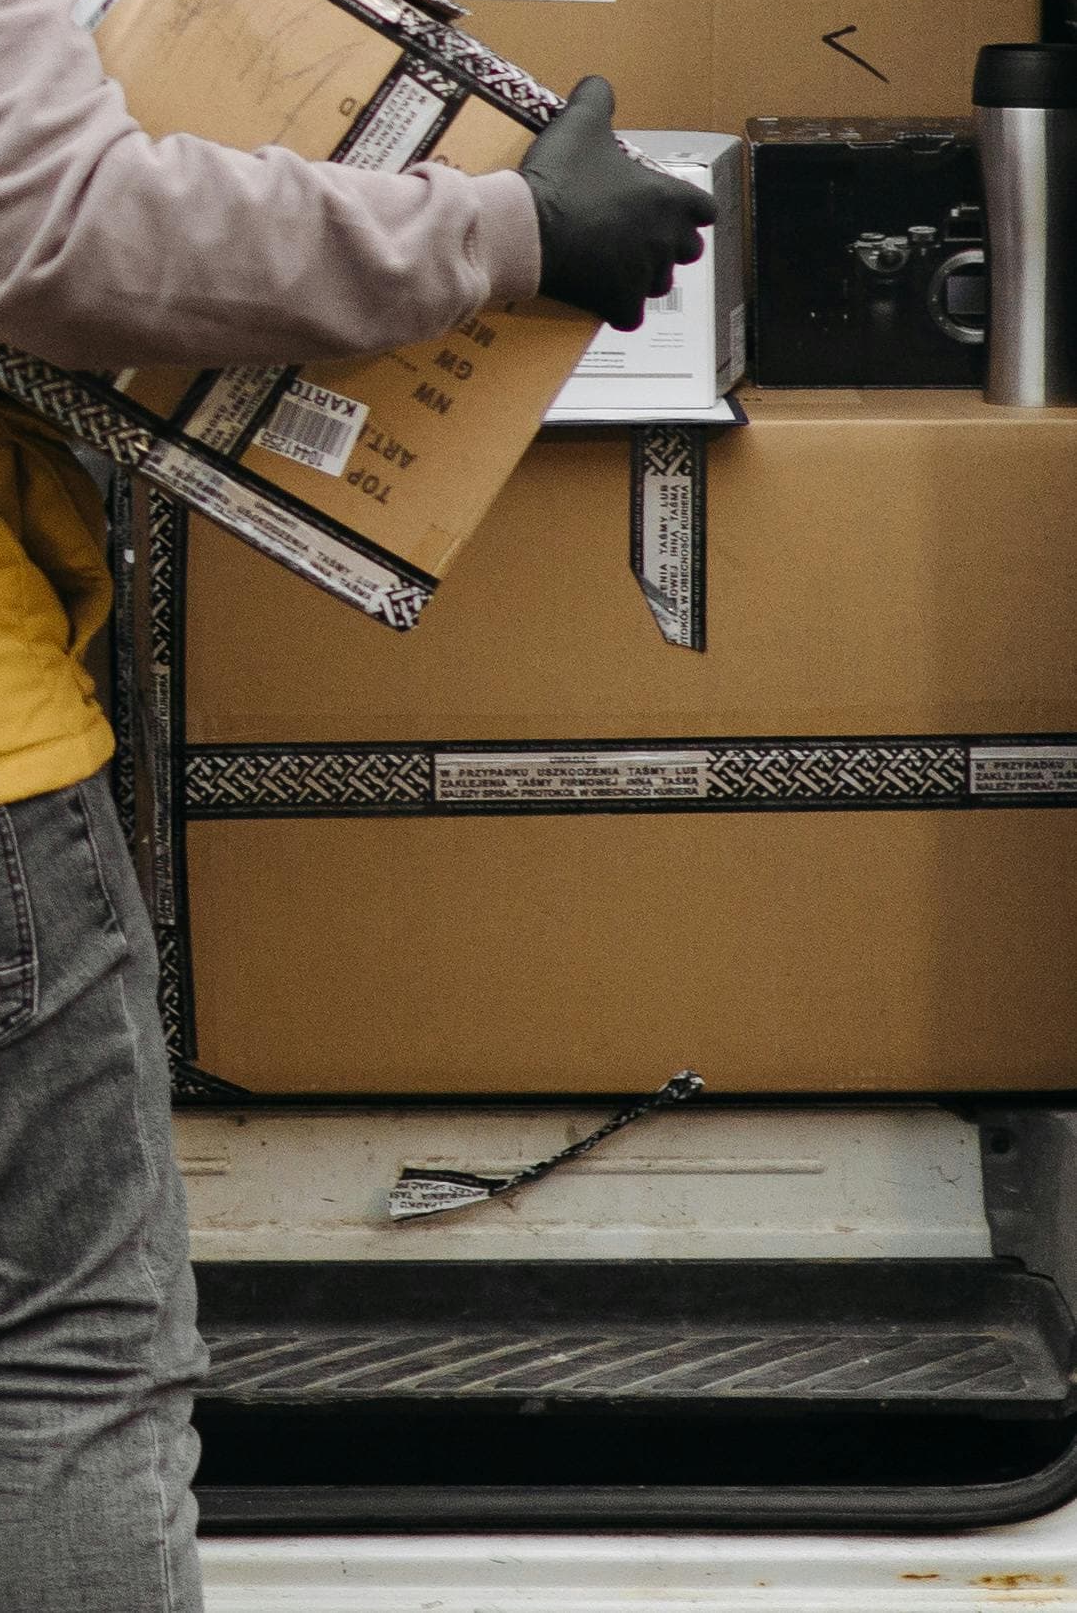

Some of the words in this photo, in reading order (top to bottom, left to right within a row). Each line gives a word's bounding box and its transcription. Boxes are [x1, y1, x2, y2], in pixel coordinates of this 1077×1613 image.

[347, 468, 393, 505] TOP
[660, 484, 668, 506] LUB
[670, 484, 680, 520] TAŚMĄ
[681, 484, 689, 529] KURIERA
[659, 516, 668, 553] TAŚMY
[670, 530, 680, 556] INNĄ
[681, 595, 689, 603] W
[441, 778, 507, 787] ZAKLEJENIA
[517, 777, 551, 787] TAŚMY
[561, 777, 618, 787] FIRMOWEJ
[661, 776, 698, 787] TAŚMĄ
[459, 768, 528, 777] PRZYPADKU
[538, 767, 619, 777] USZKODZENIA
[628, 765, 666, 776] TAŚMY
[676, 767, 698, 775] LUB
[441, 789, 481, 798] NALEŻY
[483, 787, 519, 797] SPISAĆ
[522, 787, 577, 797] PROTOKÓŁ
[579, 788, 589, 797] W
[591, 787, 651, 797] OBECNOŚCI
[653, 787, 698, 797] KURIERA
